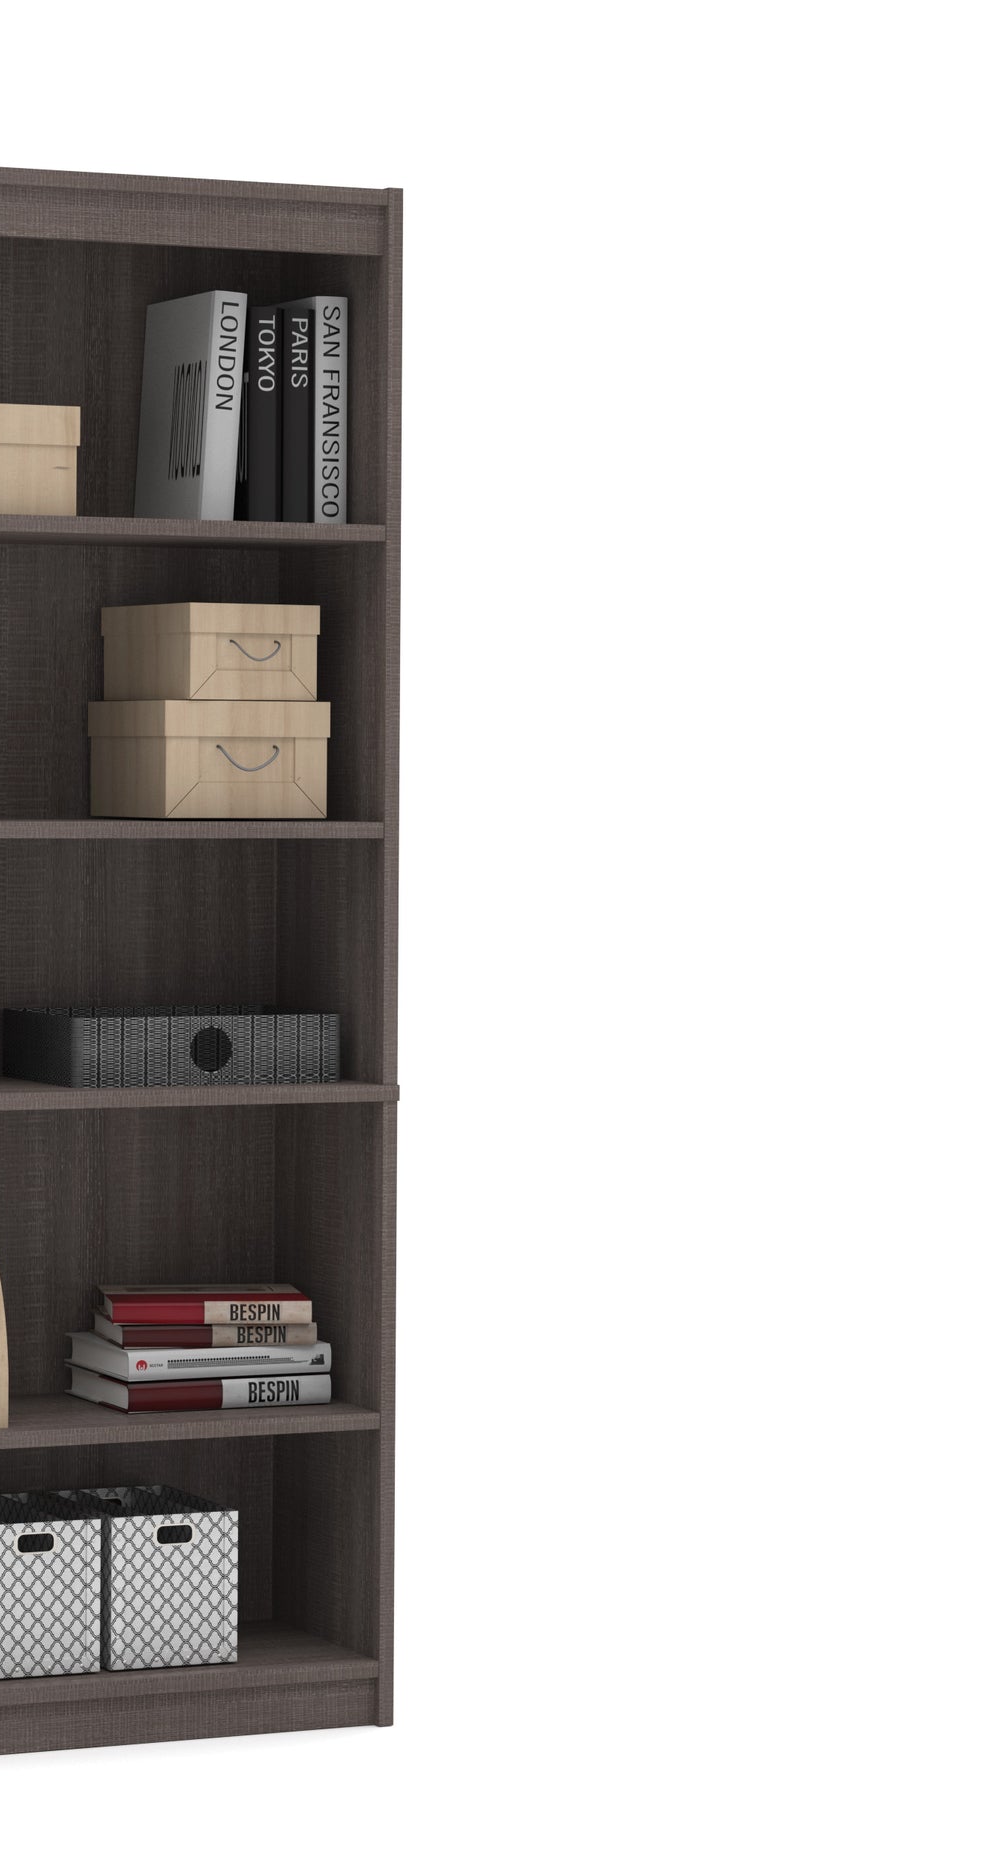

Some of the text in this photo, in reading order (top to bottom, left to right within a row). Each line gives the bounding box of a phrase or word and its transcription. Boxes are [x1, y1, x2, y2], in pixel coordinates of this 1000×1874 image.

[215, 301, 240, 411] LONDON
[257, 314, 276, 392] TOKYO
[291, 317, 308, 388] PARIS
[321, 305, 341, 518] SAN FRANSISCO
[229, 1303, 281, 1321] BESPIN
[237, 1326, 287, 1344] BESPIN
[248, 1379, 300, 1404] BESPIN
